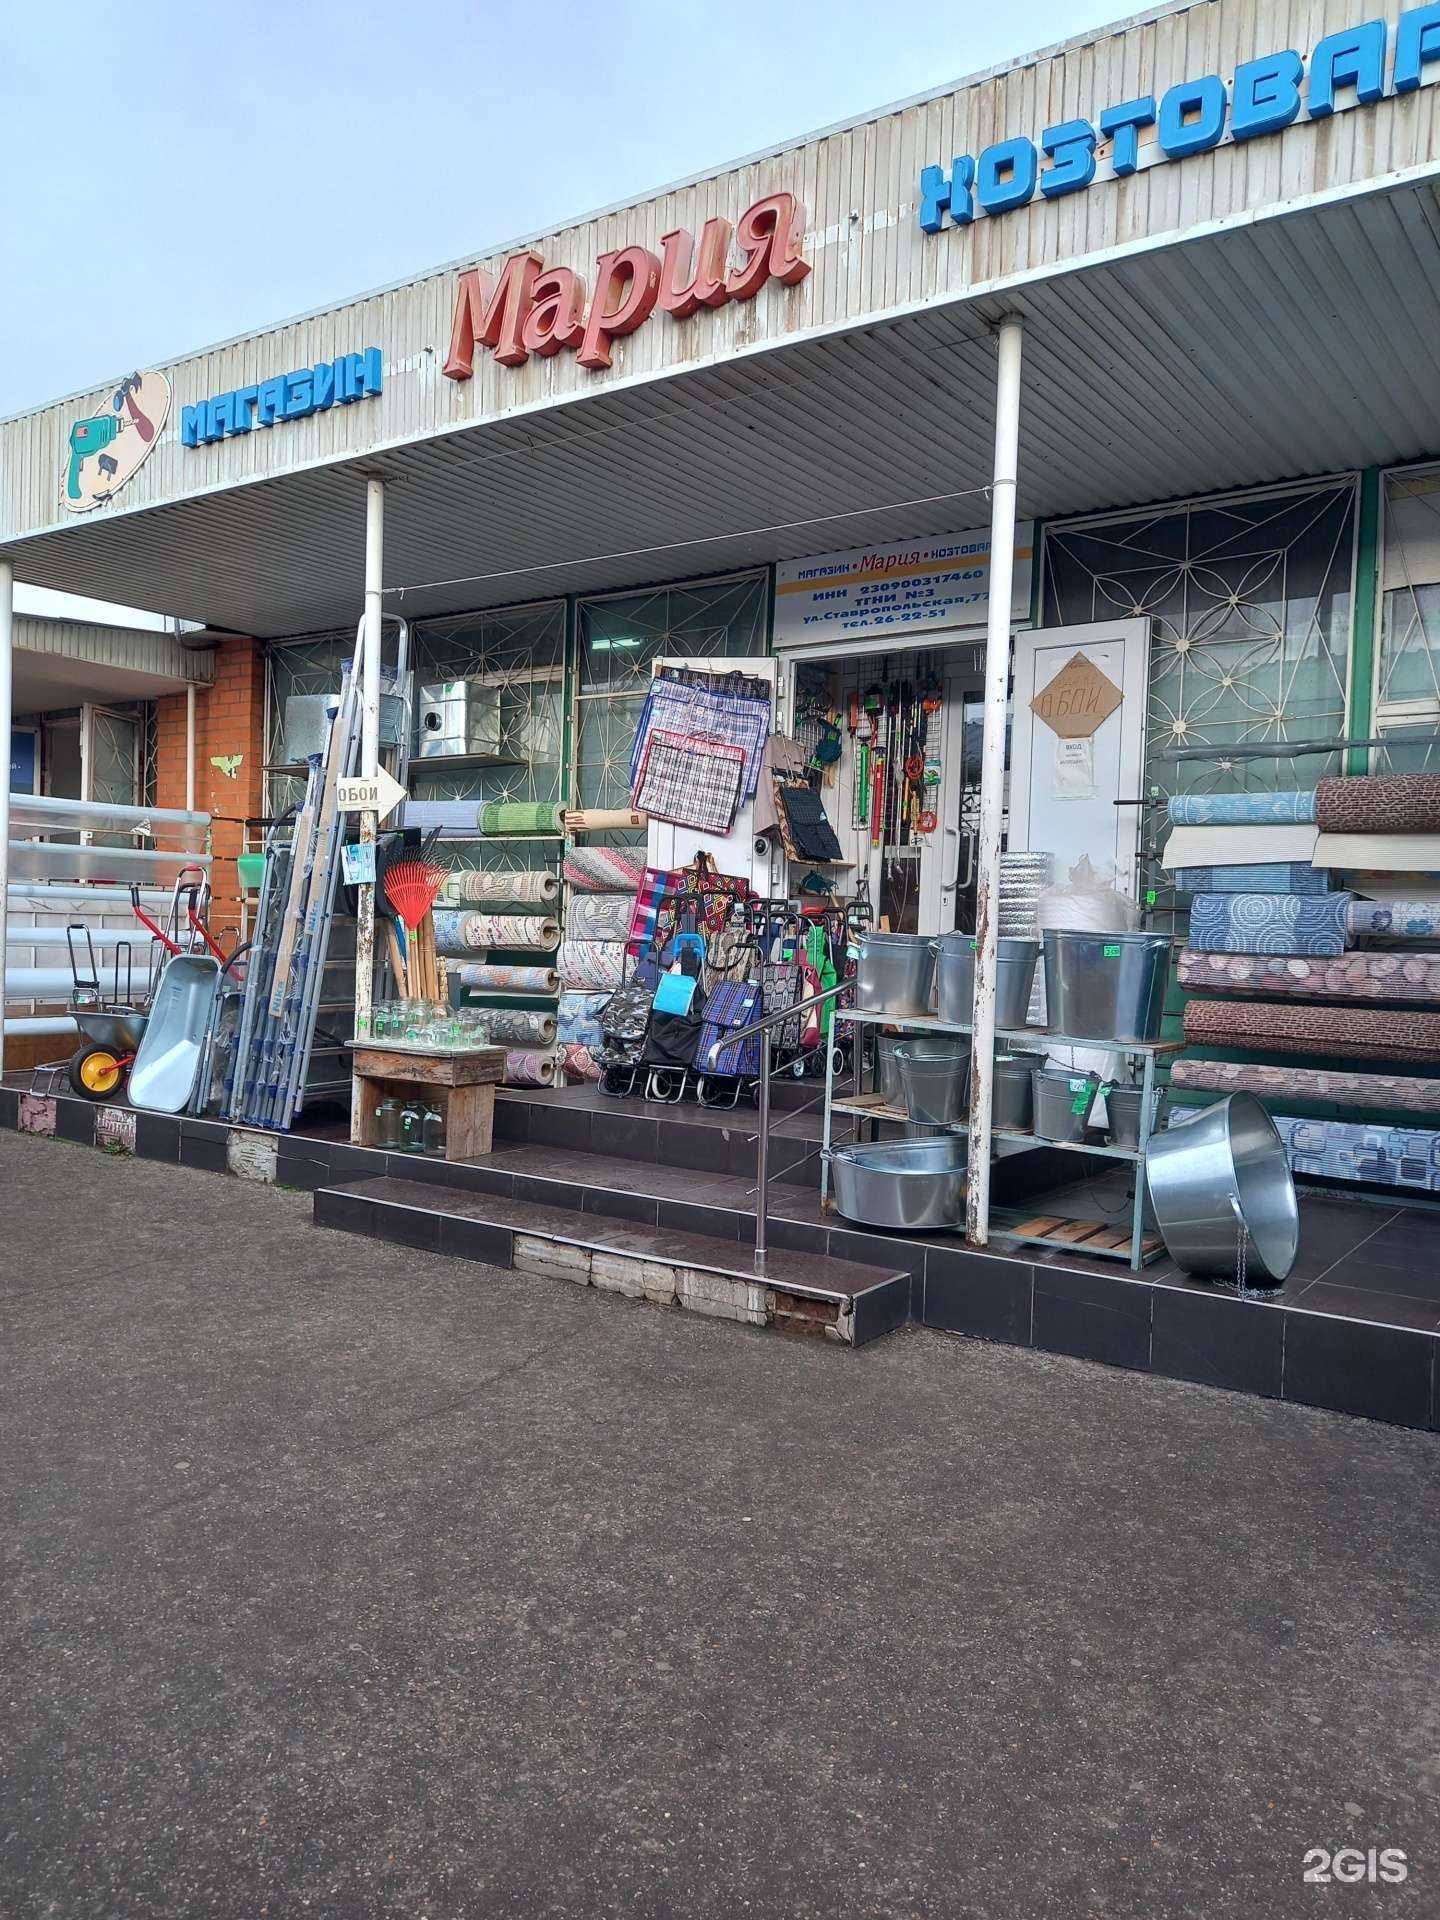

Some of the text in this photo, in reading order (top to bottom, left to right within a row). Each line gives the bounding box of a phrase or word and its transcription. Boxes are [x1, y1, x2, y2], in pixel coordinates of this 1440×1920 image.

[181, 347, 383, 448] МАГАЗИН
[442, 192, 812, 380] Мария
[798, 563, 850, 579] МАГАЗИН
[860, 551, 920, 573] Мария
[812, 569, 984, 601] ИНН 230900317460
[905, 588, 935, 600] №3
[841, 608, 946, 628] тел.26-22-51
[338, 786, 378, 801] ОБОИ
